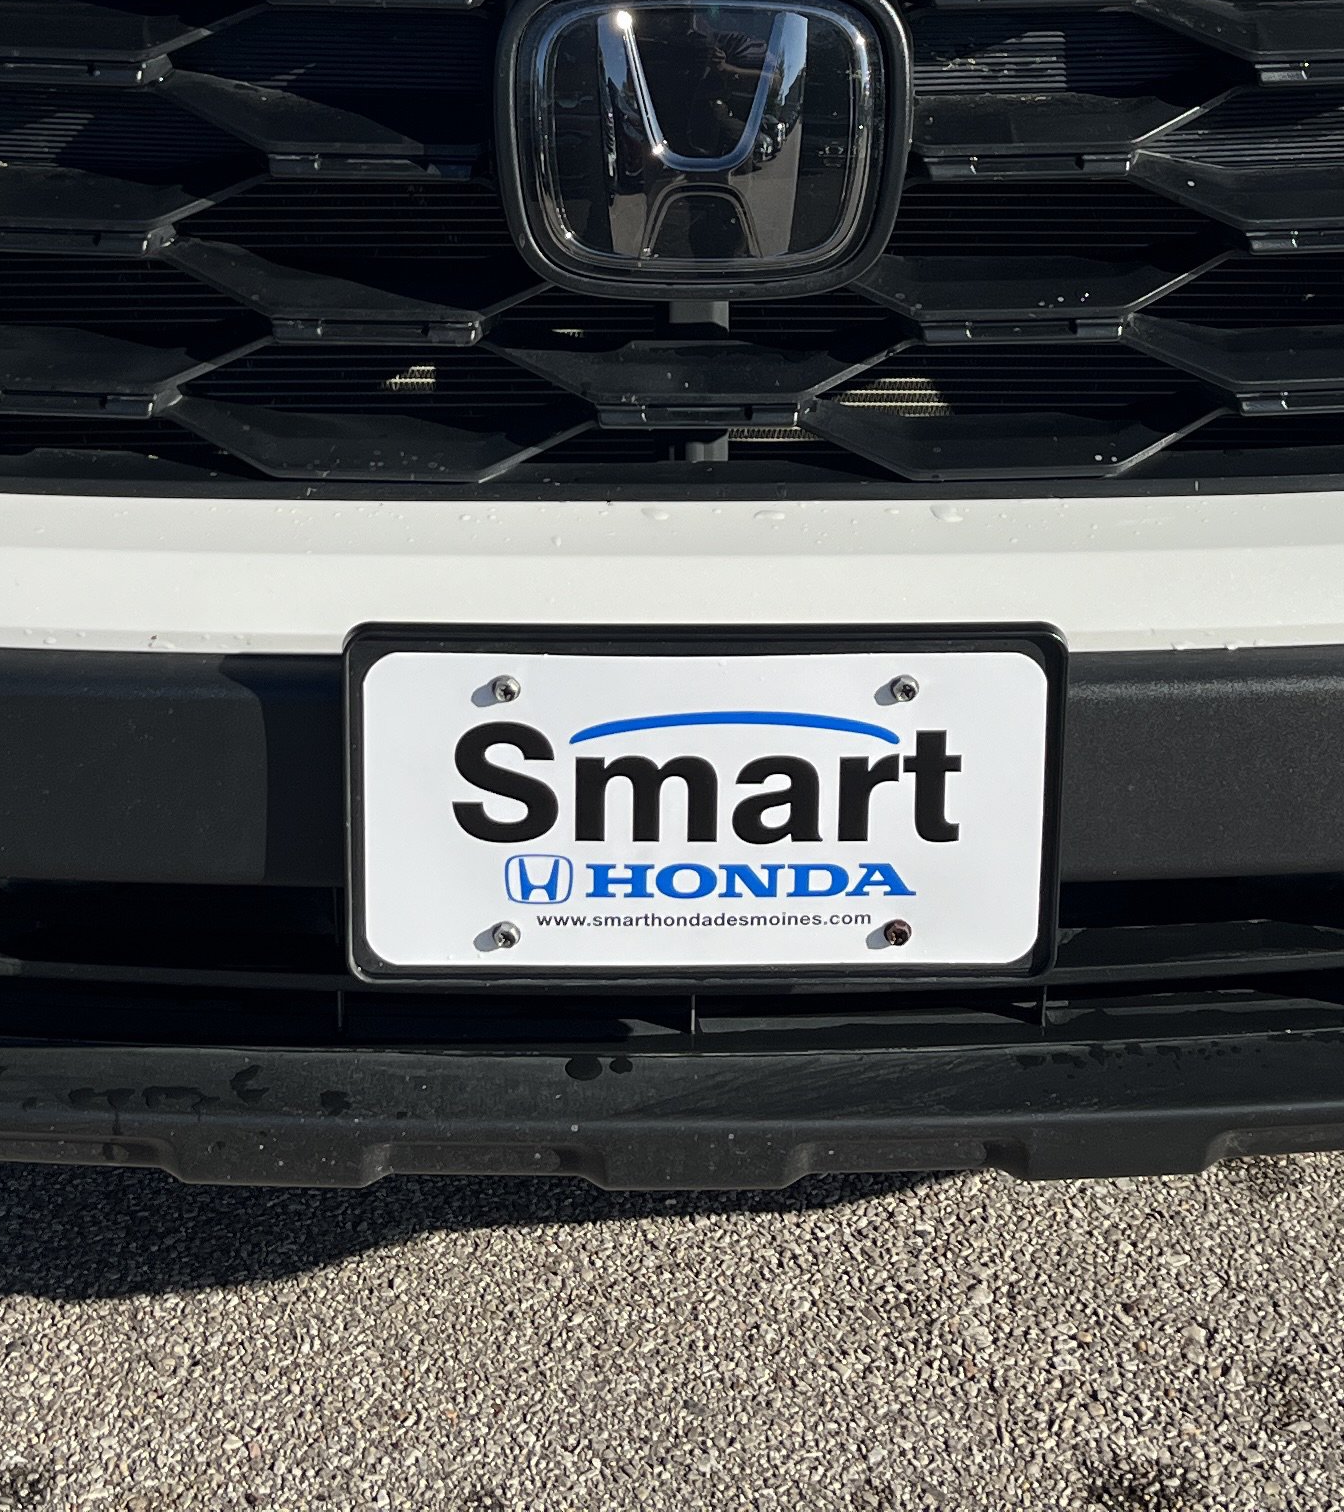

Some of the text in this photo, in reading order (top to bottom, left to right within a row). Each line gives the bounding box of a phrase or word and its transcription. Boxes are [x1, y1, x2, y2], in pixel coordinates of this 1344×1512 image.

[452, 721, 962, 844] Smart
[585, 862, 916, 898] HONDA
[536, 911, 872, 928] www.smarthondadesmoines.com
